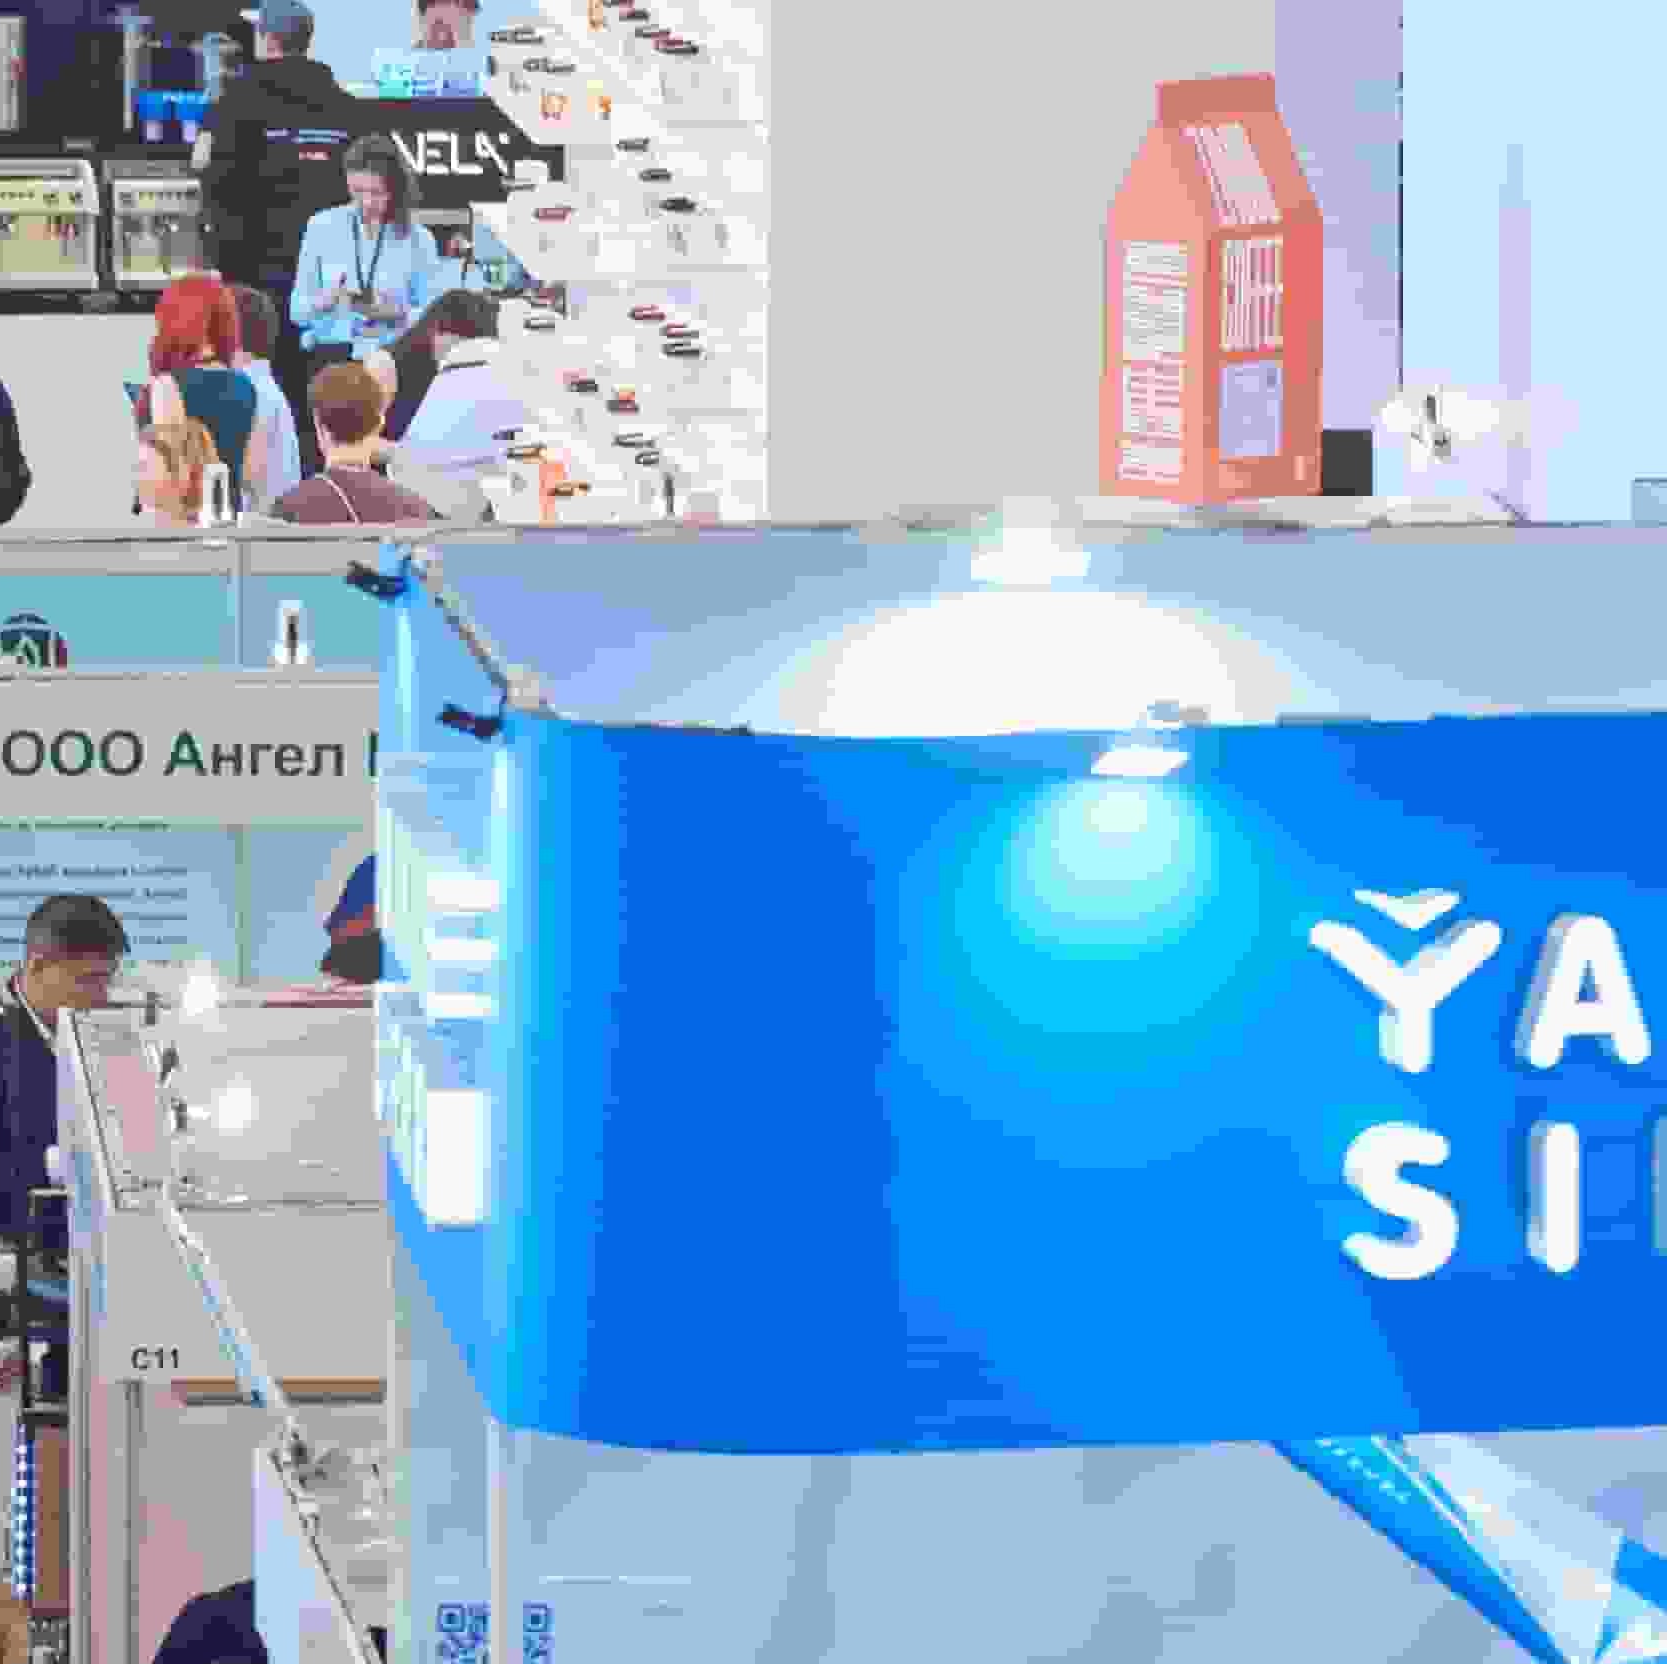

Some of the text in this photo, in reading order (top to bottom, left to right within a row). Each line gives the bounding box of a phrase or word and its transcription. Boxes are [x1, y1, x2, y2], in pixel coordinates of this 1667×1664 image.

[1, 729, 145, 777] ООО
[165, 728, 348, 777] Ангел
[131, 1347, 179, 1371] C11
